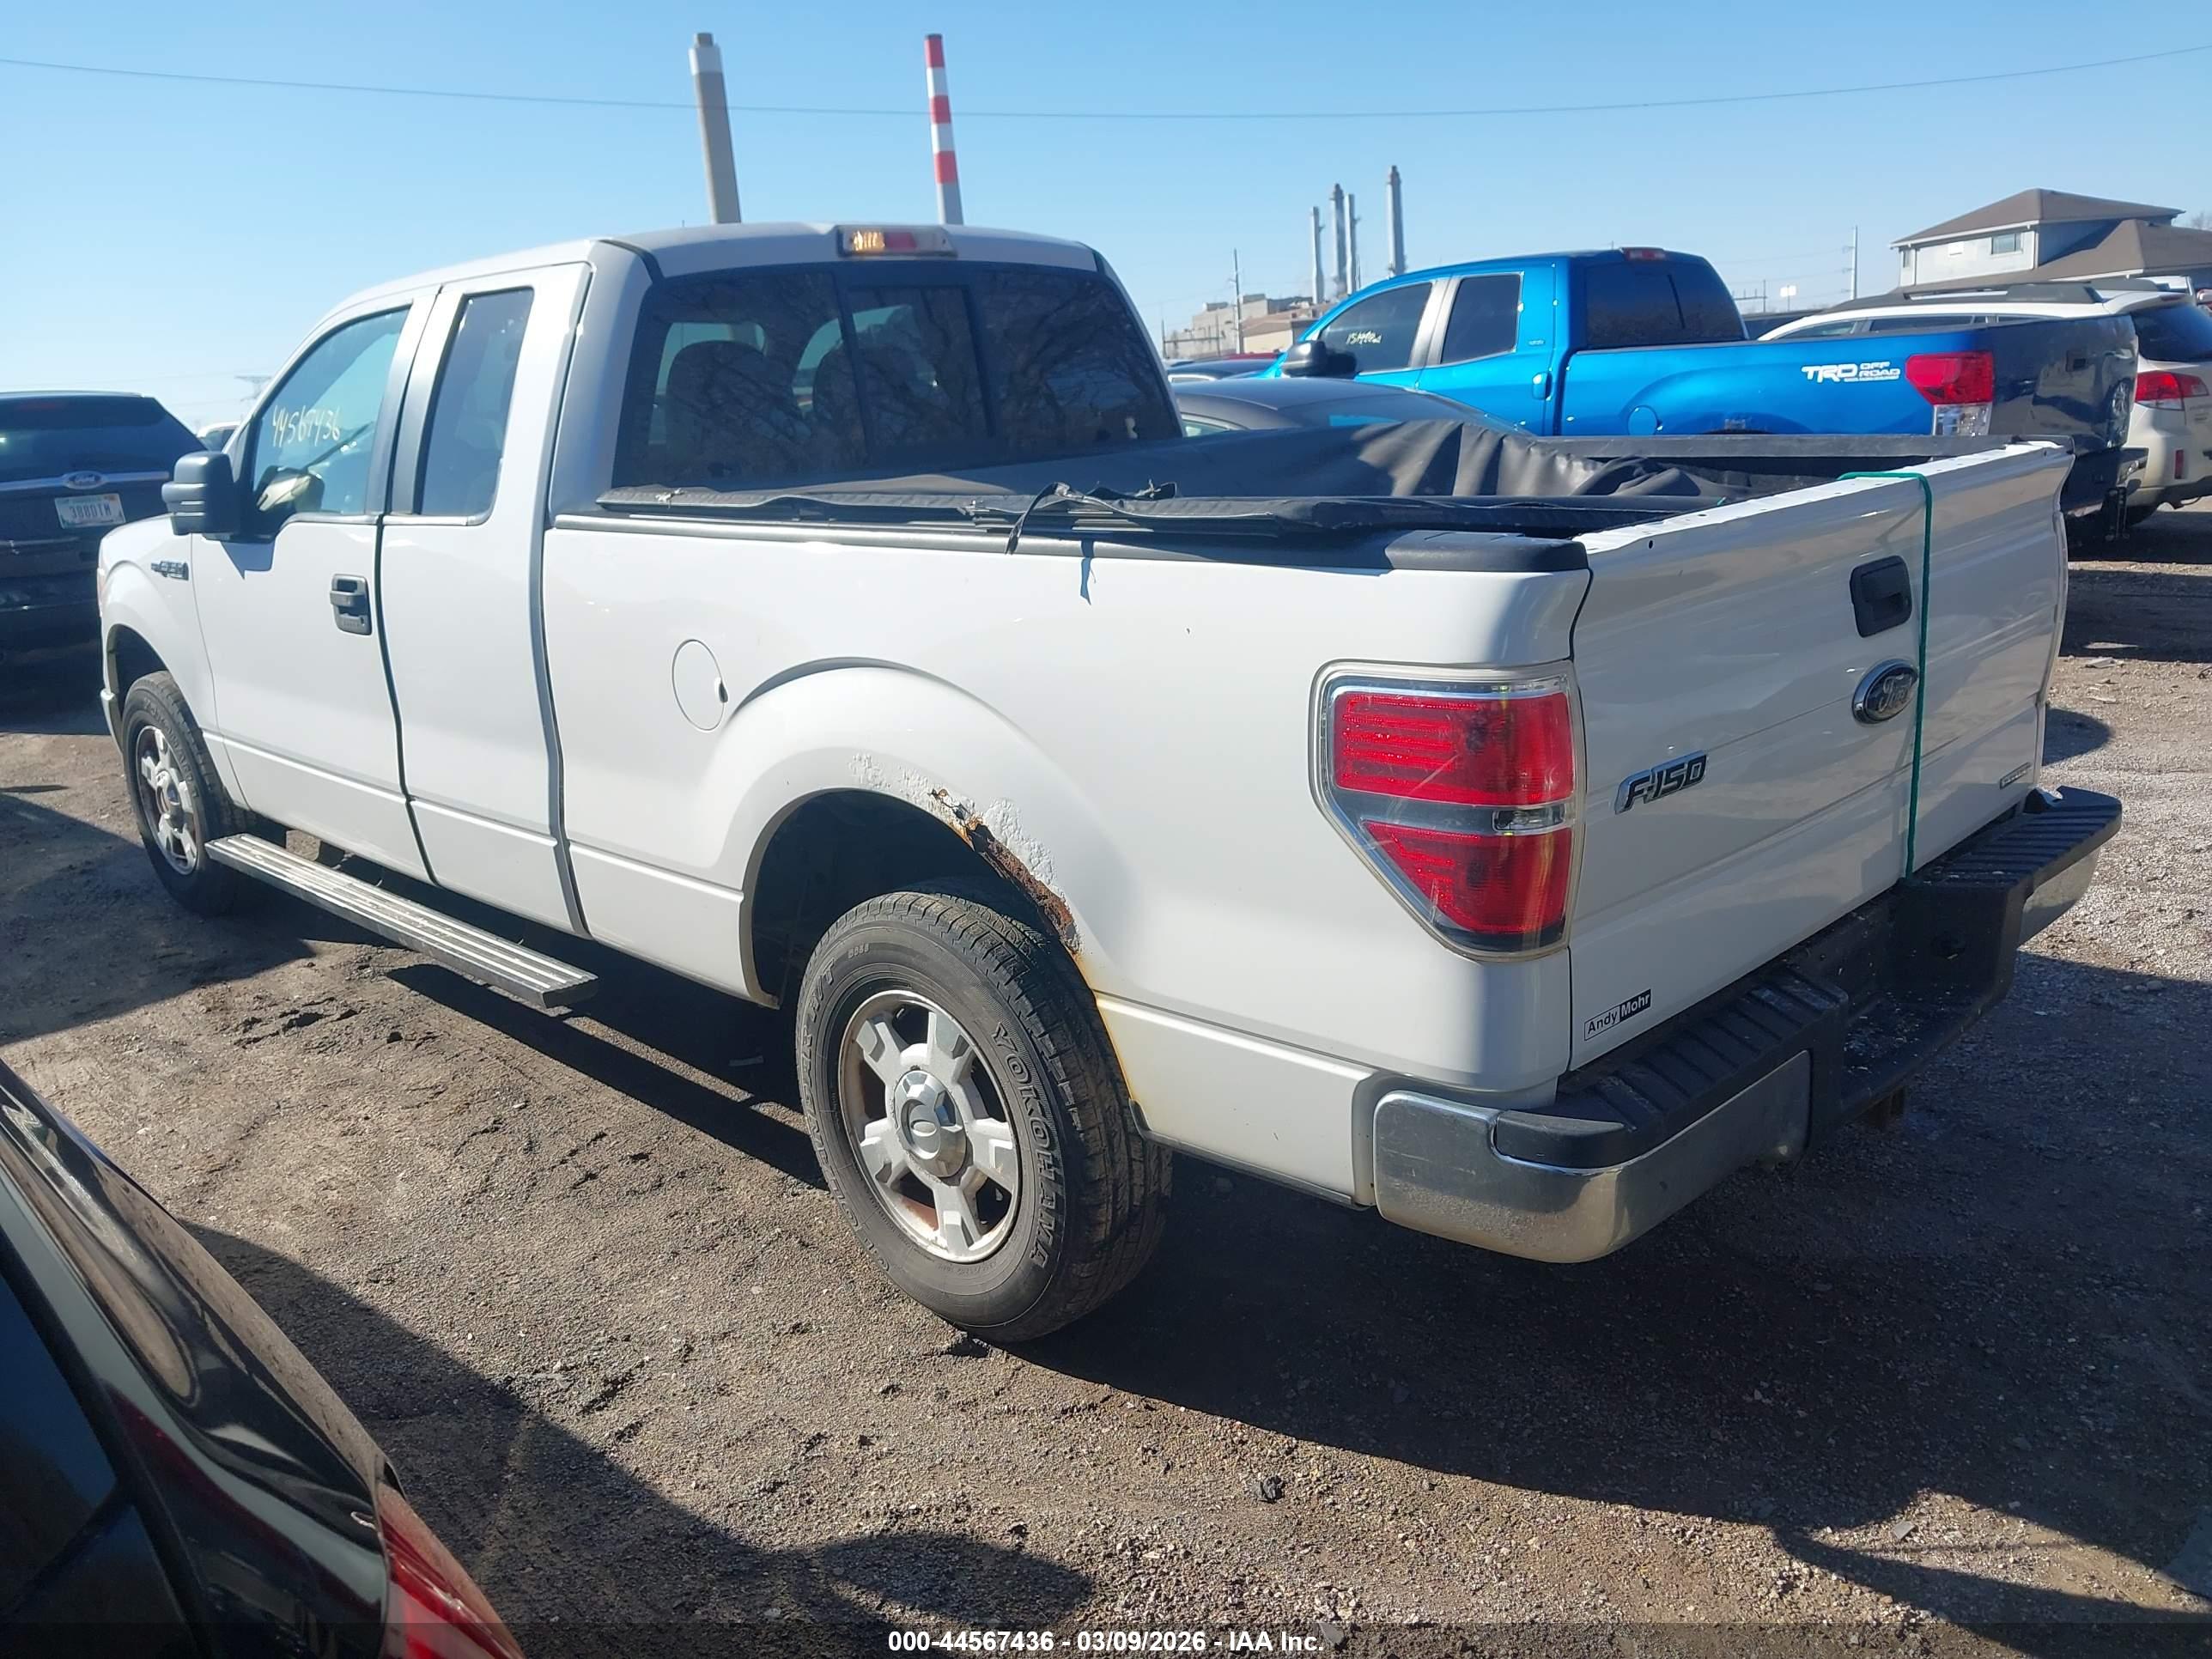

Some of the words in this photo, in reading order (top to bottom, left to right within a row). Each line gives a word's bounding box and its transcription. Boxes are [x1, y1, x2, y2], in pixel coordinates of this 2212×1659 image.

[1801, 363, 1858, 384] TRD
[1858, 368, 1900, 378] ROAD
[1859, 361, 1891, 370] OFF
[272, 404, 341, 447] 44567436
[1587, 1012, 1618, 1035] Andy
[1620, 994, 1650, 1018] Mohr
[990, 1021, 1059, 1269] YOKOHAMA
